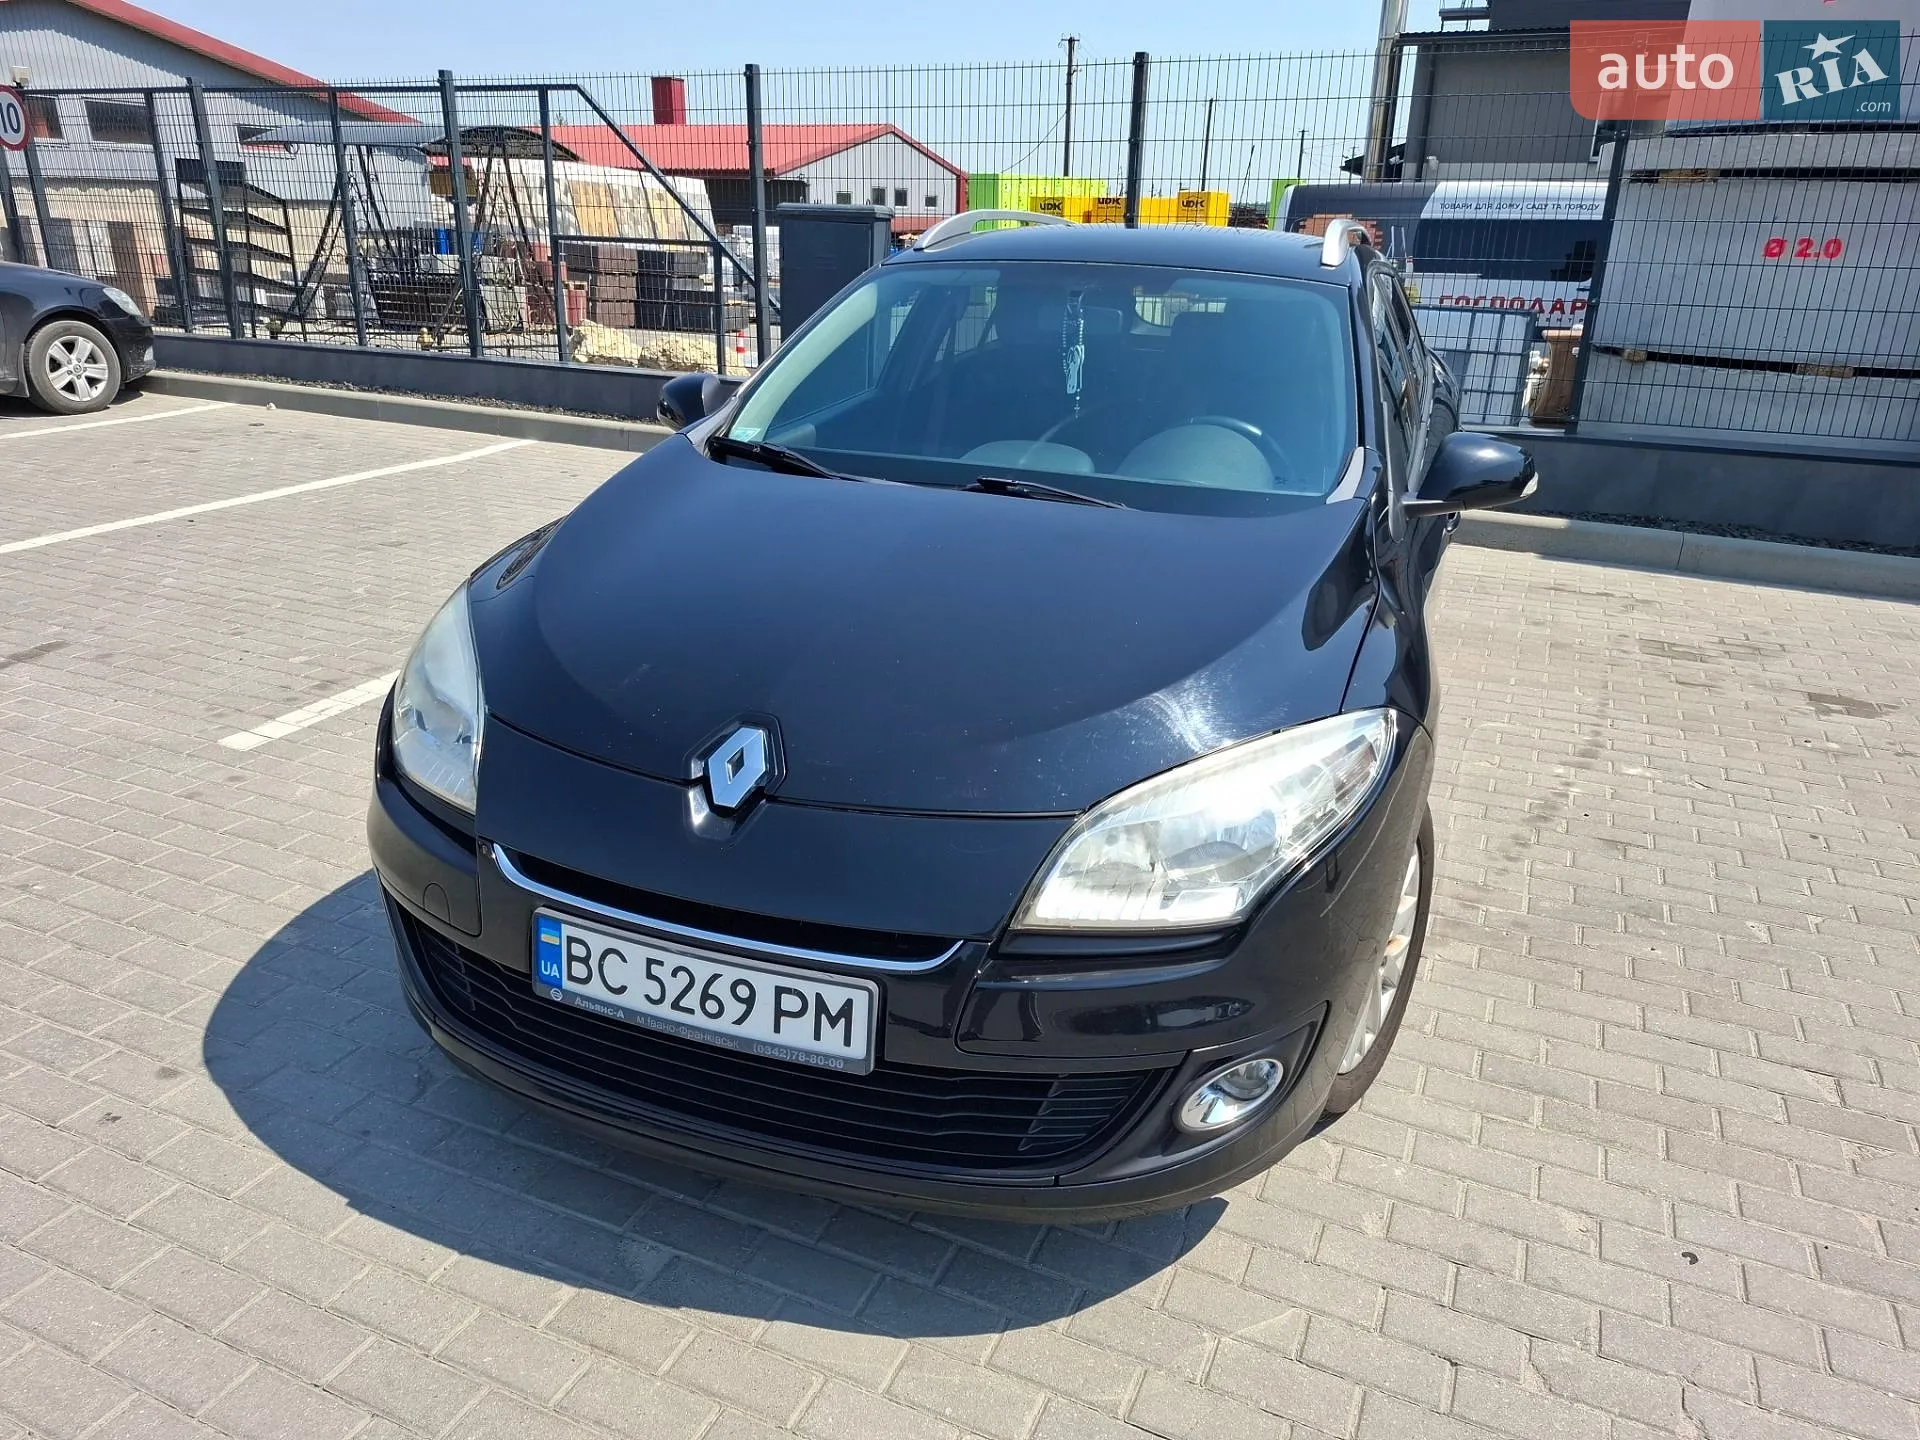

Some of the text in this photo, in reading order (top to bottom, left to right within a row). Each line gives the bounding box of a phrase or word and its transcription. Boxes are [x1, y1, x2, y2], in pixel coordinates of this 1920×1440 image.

[1039, 202, 1063, 211] UDK
[1097, 197, 1121, 205] UDK
[1181, 199, 1205, 208] UDK
[1526, 202, 1549, 210] САДУ
[1794, 237, 1843, 258] 2.0
[541, 960, 560, 979] UA
[566, 935, 853, 1047] BC 5269 PM
[574, 997, 625, 1019] Альянс-А
